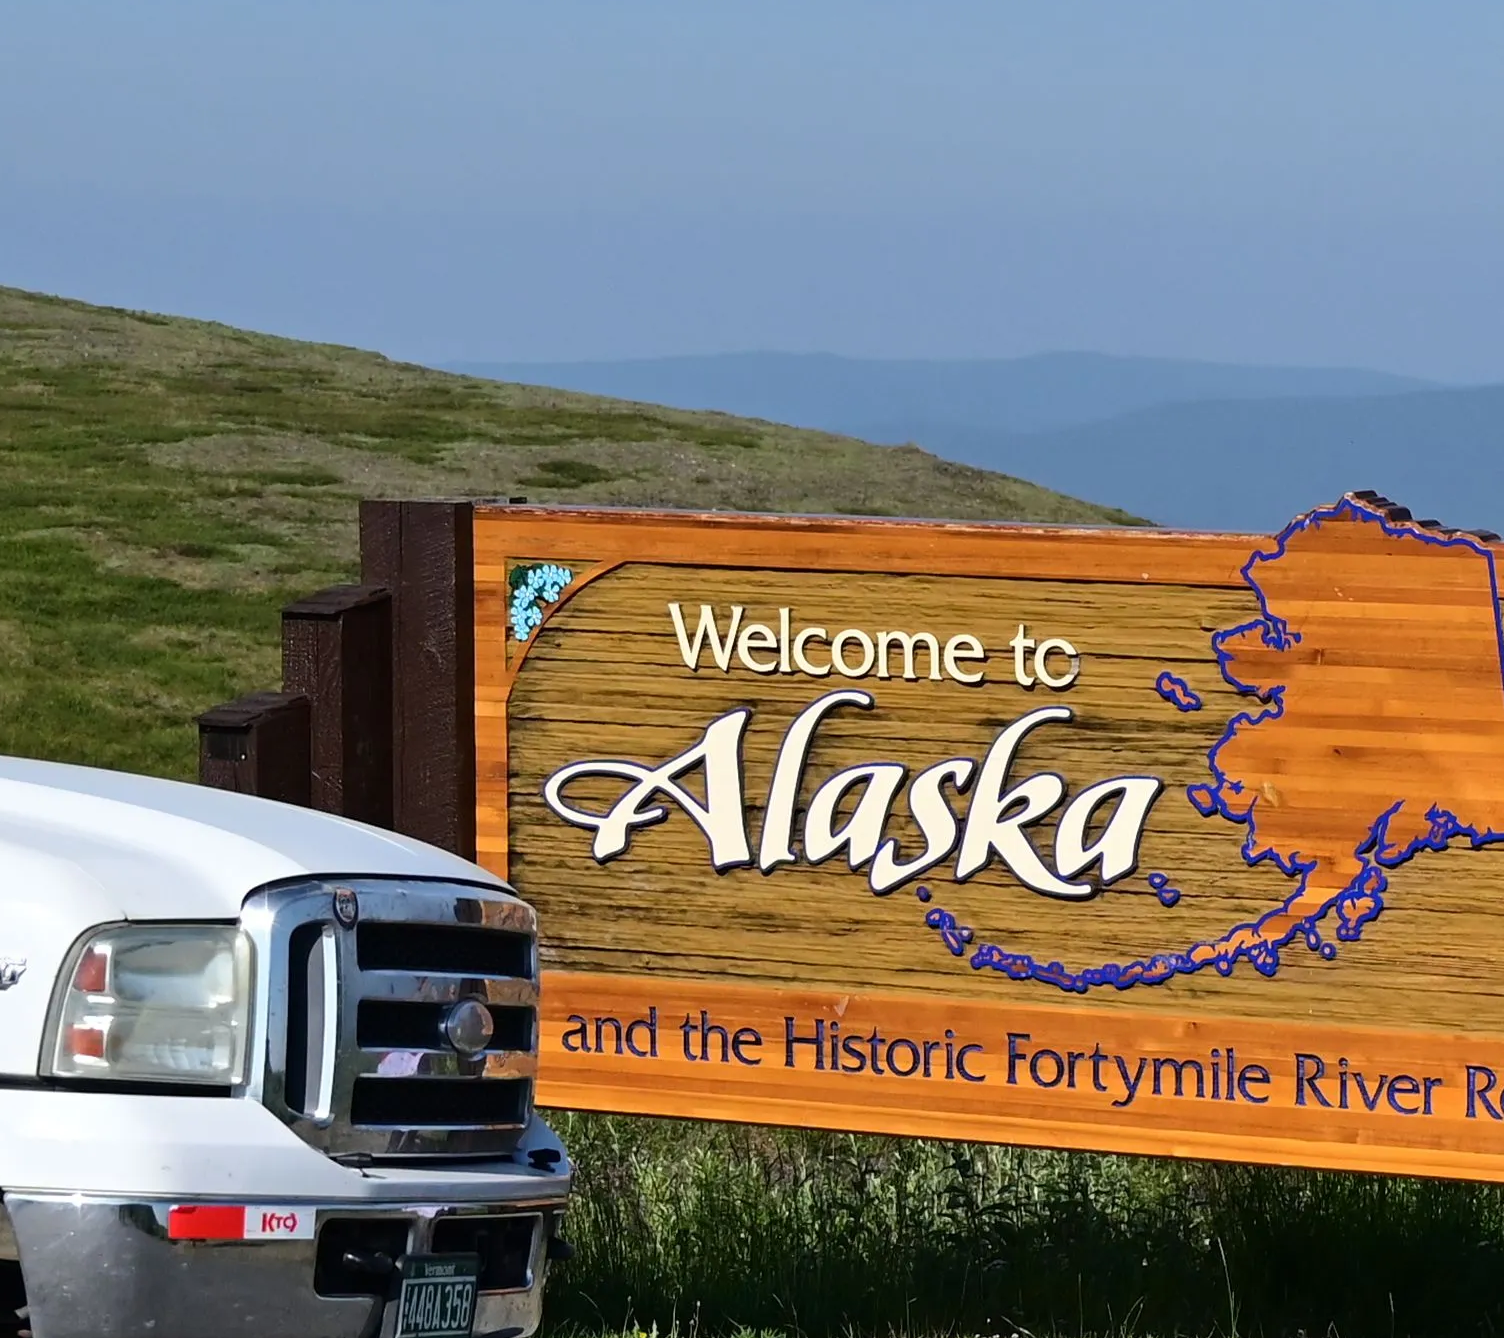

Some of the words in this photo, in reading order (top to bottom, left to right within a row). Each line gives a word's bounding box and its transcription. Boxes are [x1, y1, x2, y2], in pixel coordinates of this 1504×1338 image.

[668, 602, 986, 686] Welcome
[1008, 622, 1081, 688] to
[543, 689, 1163, 900] Alaska
[562, 1006, 658, 1057] and
[680, 1010, 763, 1066] the
[783, 1017, 986, 1083] Historic
[1006, 1032, 1271, 1108] Fortymile
[1295, 1052, 1444, 1116] River
[424, 1262, 456, 1277] Vermont
